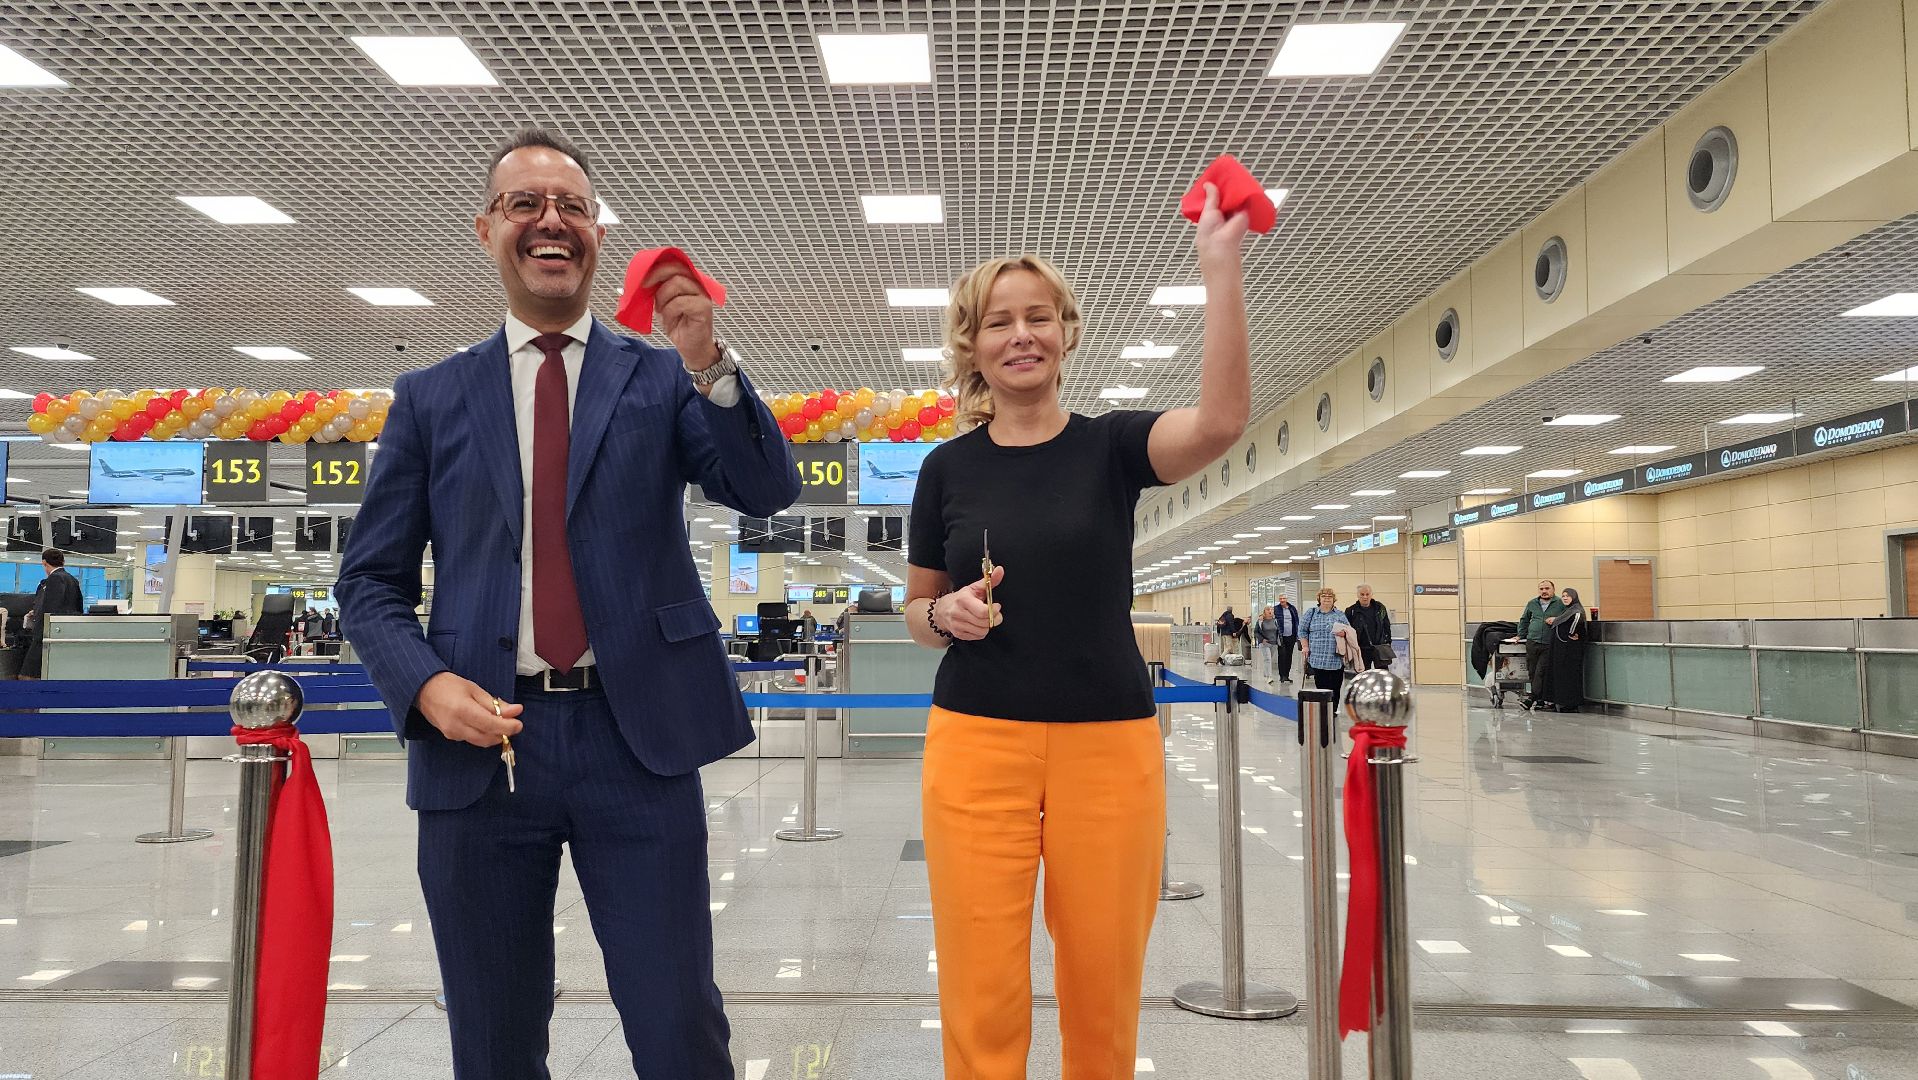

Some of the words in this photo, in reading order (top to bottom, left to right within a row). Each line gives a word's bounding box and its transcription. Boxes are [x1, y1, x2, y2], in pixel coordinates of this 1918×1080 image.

[1827, 418, 1884, 440] DOMODEDOVO
[1731, 444, 1777, 461] DOMODEDOVO
[211, 458, 262, 484] 153
[311, 460, 361, 485] 152
